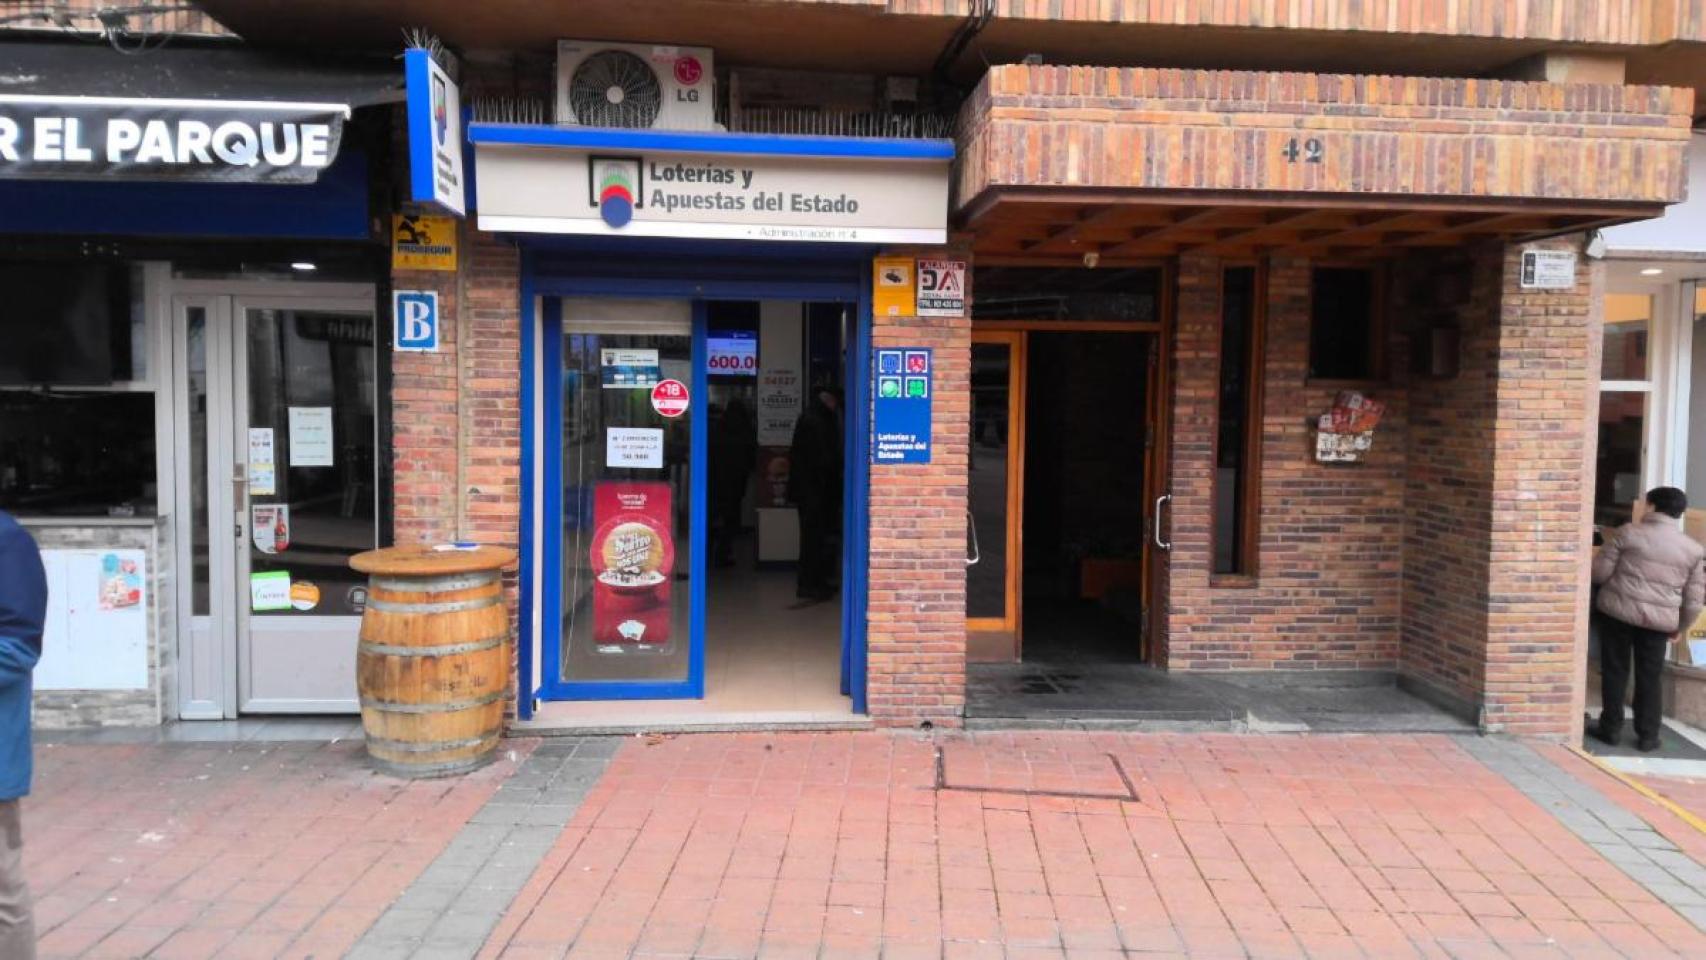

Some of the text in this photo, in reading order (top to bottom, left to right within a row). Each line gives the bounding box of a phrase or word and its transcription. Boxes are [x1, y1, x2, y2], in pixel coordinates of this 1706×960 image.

[677, 89, 699, 103] LG
[34, 117, 92, 162] EL
[107, 119, 330, 168] PARQUE
[1281, 138, 1322, 163] 42
[650, 161, 753, 190] Loterías y
[650, 189, 859, 214] Apuestas del Estado
[401, 300, 432, 341] B
[660, 383, 681, 396] +18
